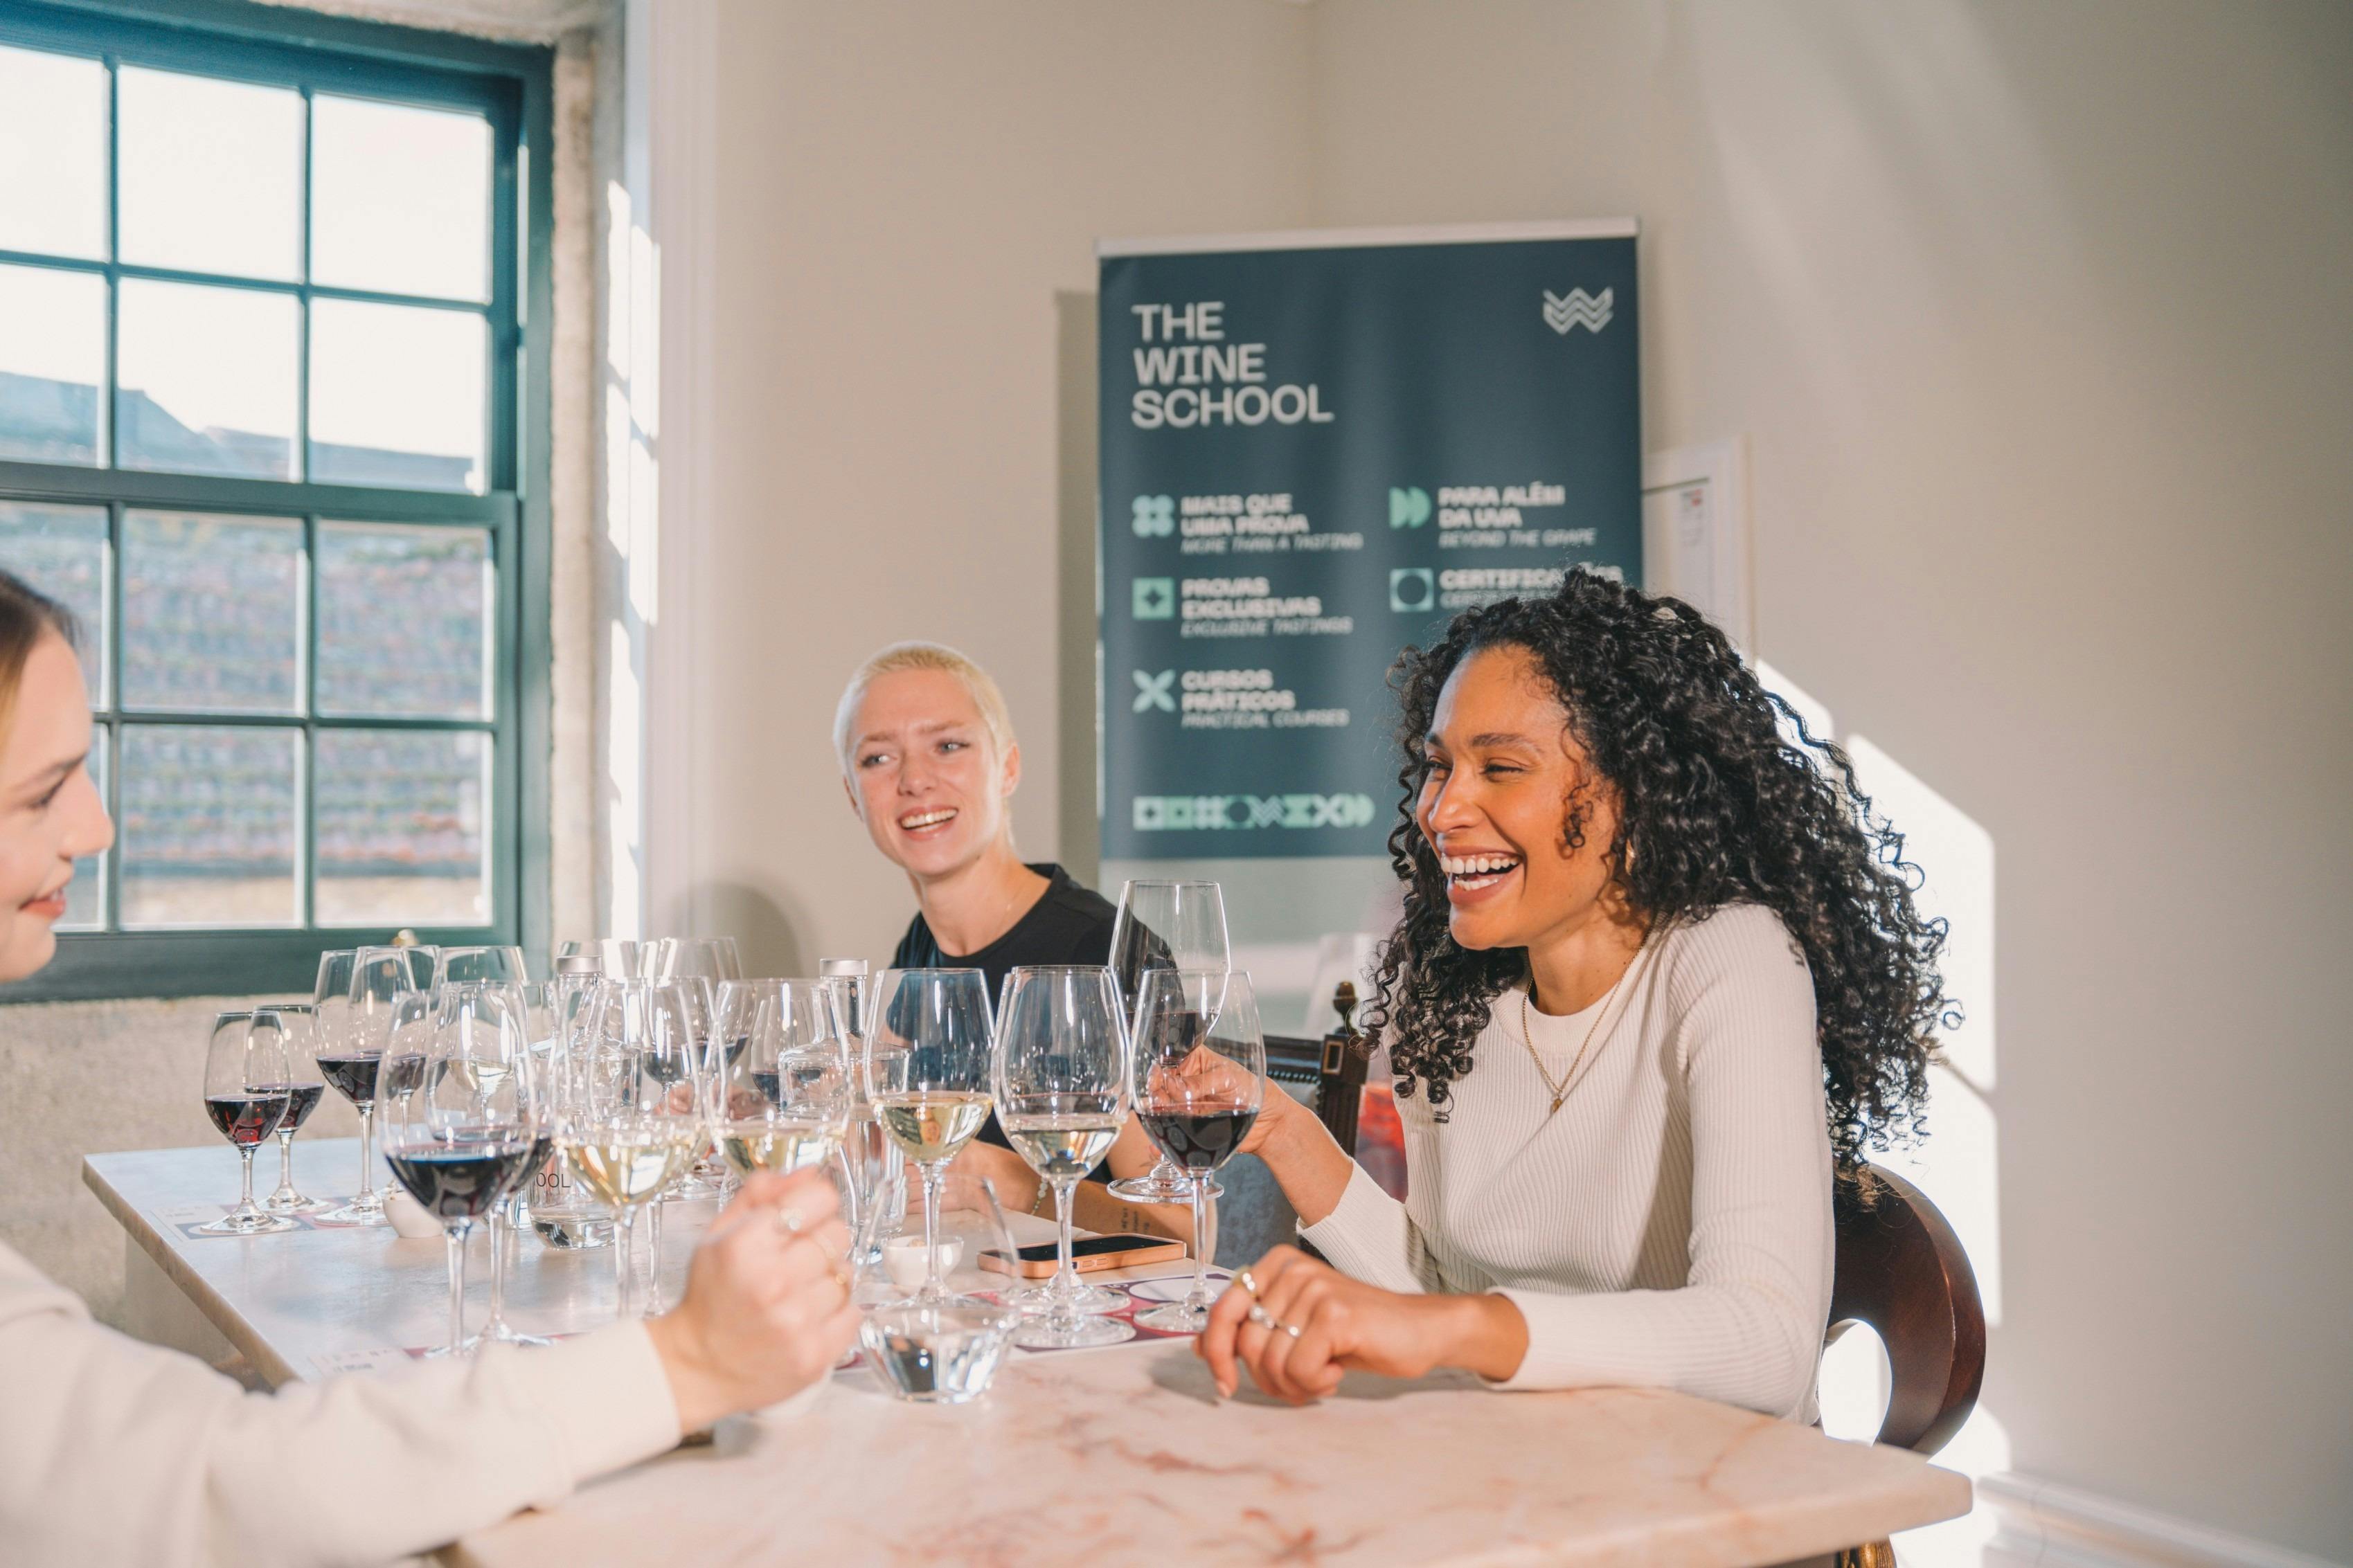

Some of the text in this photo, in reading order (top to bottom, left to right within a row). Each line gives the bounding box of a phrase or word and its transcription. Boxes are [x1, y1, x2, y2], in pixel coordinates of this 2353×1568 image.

[1131, 301, 1224, 341] THE
[1133, 343, 1267, 386] WINE
[1131, 384, 1335, 429] SCHOOL
[1438, 480, 1565, 507] PARA ALÉM
[1181, 494, 1292, 516] MAIS QUE
[1181, 514, 1309, 537] UMA PROVA
[1438, 507, 1523, 529] DA UVA
[1294, 532, 1363, 550] TASTING
[1439, 528, 1597, 548] BEYOND THE GRAPE
[1181, 577, 1270, 598] PROVAS
[1181, 596, 1322, 620] EXCLUSIVAS
[1181, 616, 1353, 638] EXCLUSIVE TASTINGS
[1181, 669, 1273, 691] CURSOS
[1181, 688, 1296, 711] PRÁTICOS
[1181, 708, 1350, 728] PRACTICAL COURSES
[534, 1173, 571, 1188] OOL
